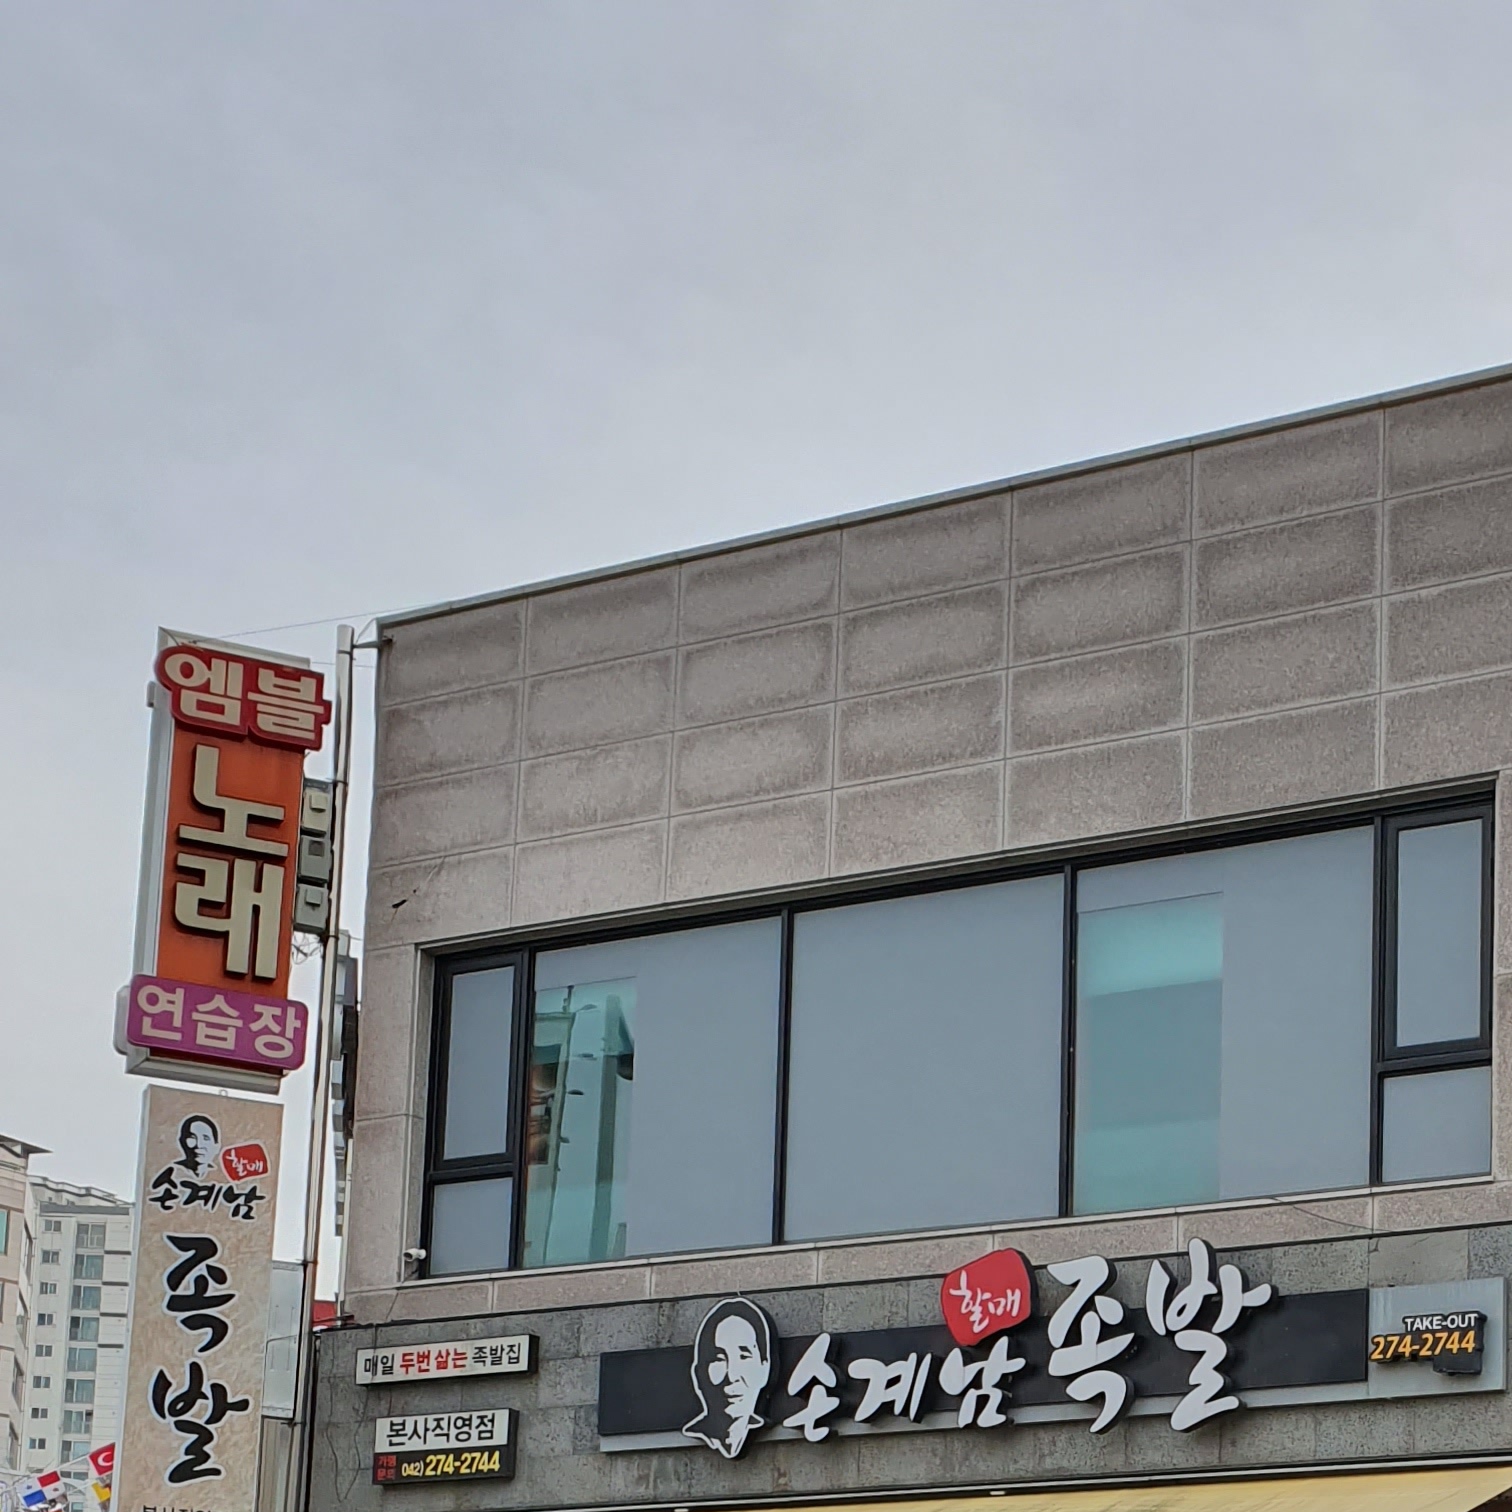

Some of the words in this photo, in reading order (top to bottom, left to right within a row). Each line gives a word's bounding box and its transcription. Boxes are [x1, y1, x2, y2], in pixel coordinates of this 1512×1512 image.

[164, 652, 325, 740] 엠블
[175, 743, 289, 979] 노래
[136, 983, 301, 1059] 연습장
[148, 1166, 266, 1220] 손계남
[783, 1333, 1026, 1442] 손계남
[1046, 1237, 1272, 1434] 족발
[1370, 1331, 1476, 1360] 274-2744
[1404, 1312, 1478, 1331] TAKE-OUT
[153, 1233, 249, 1484] 족발
[364, 1353, 395, 1376] 매일
[400, 1350, 431, 1375] 두번
[434, 1347, 468, 1371] 삶는
[472, 1343, 521, 1367] 족발집
[387, 1413, 495, 1446] 본사직영점
